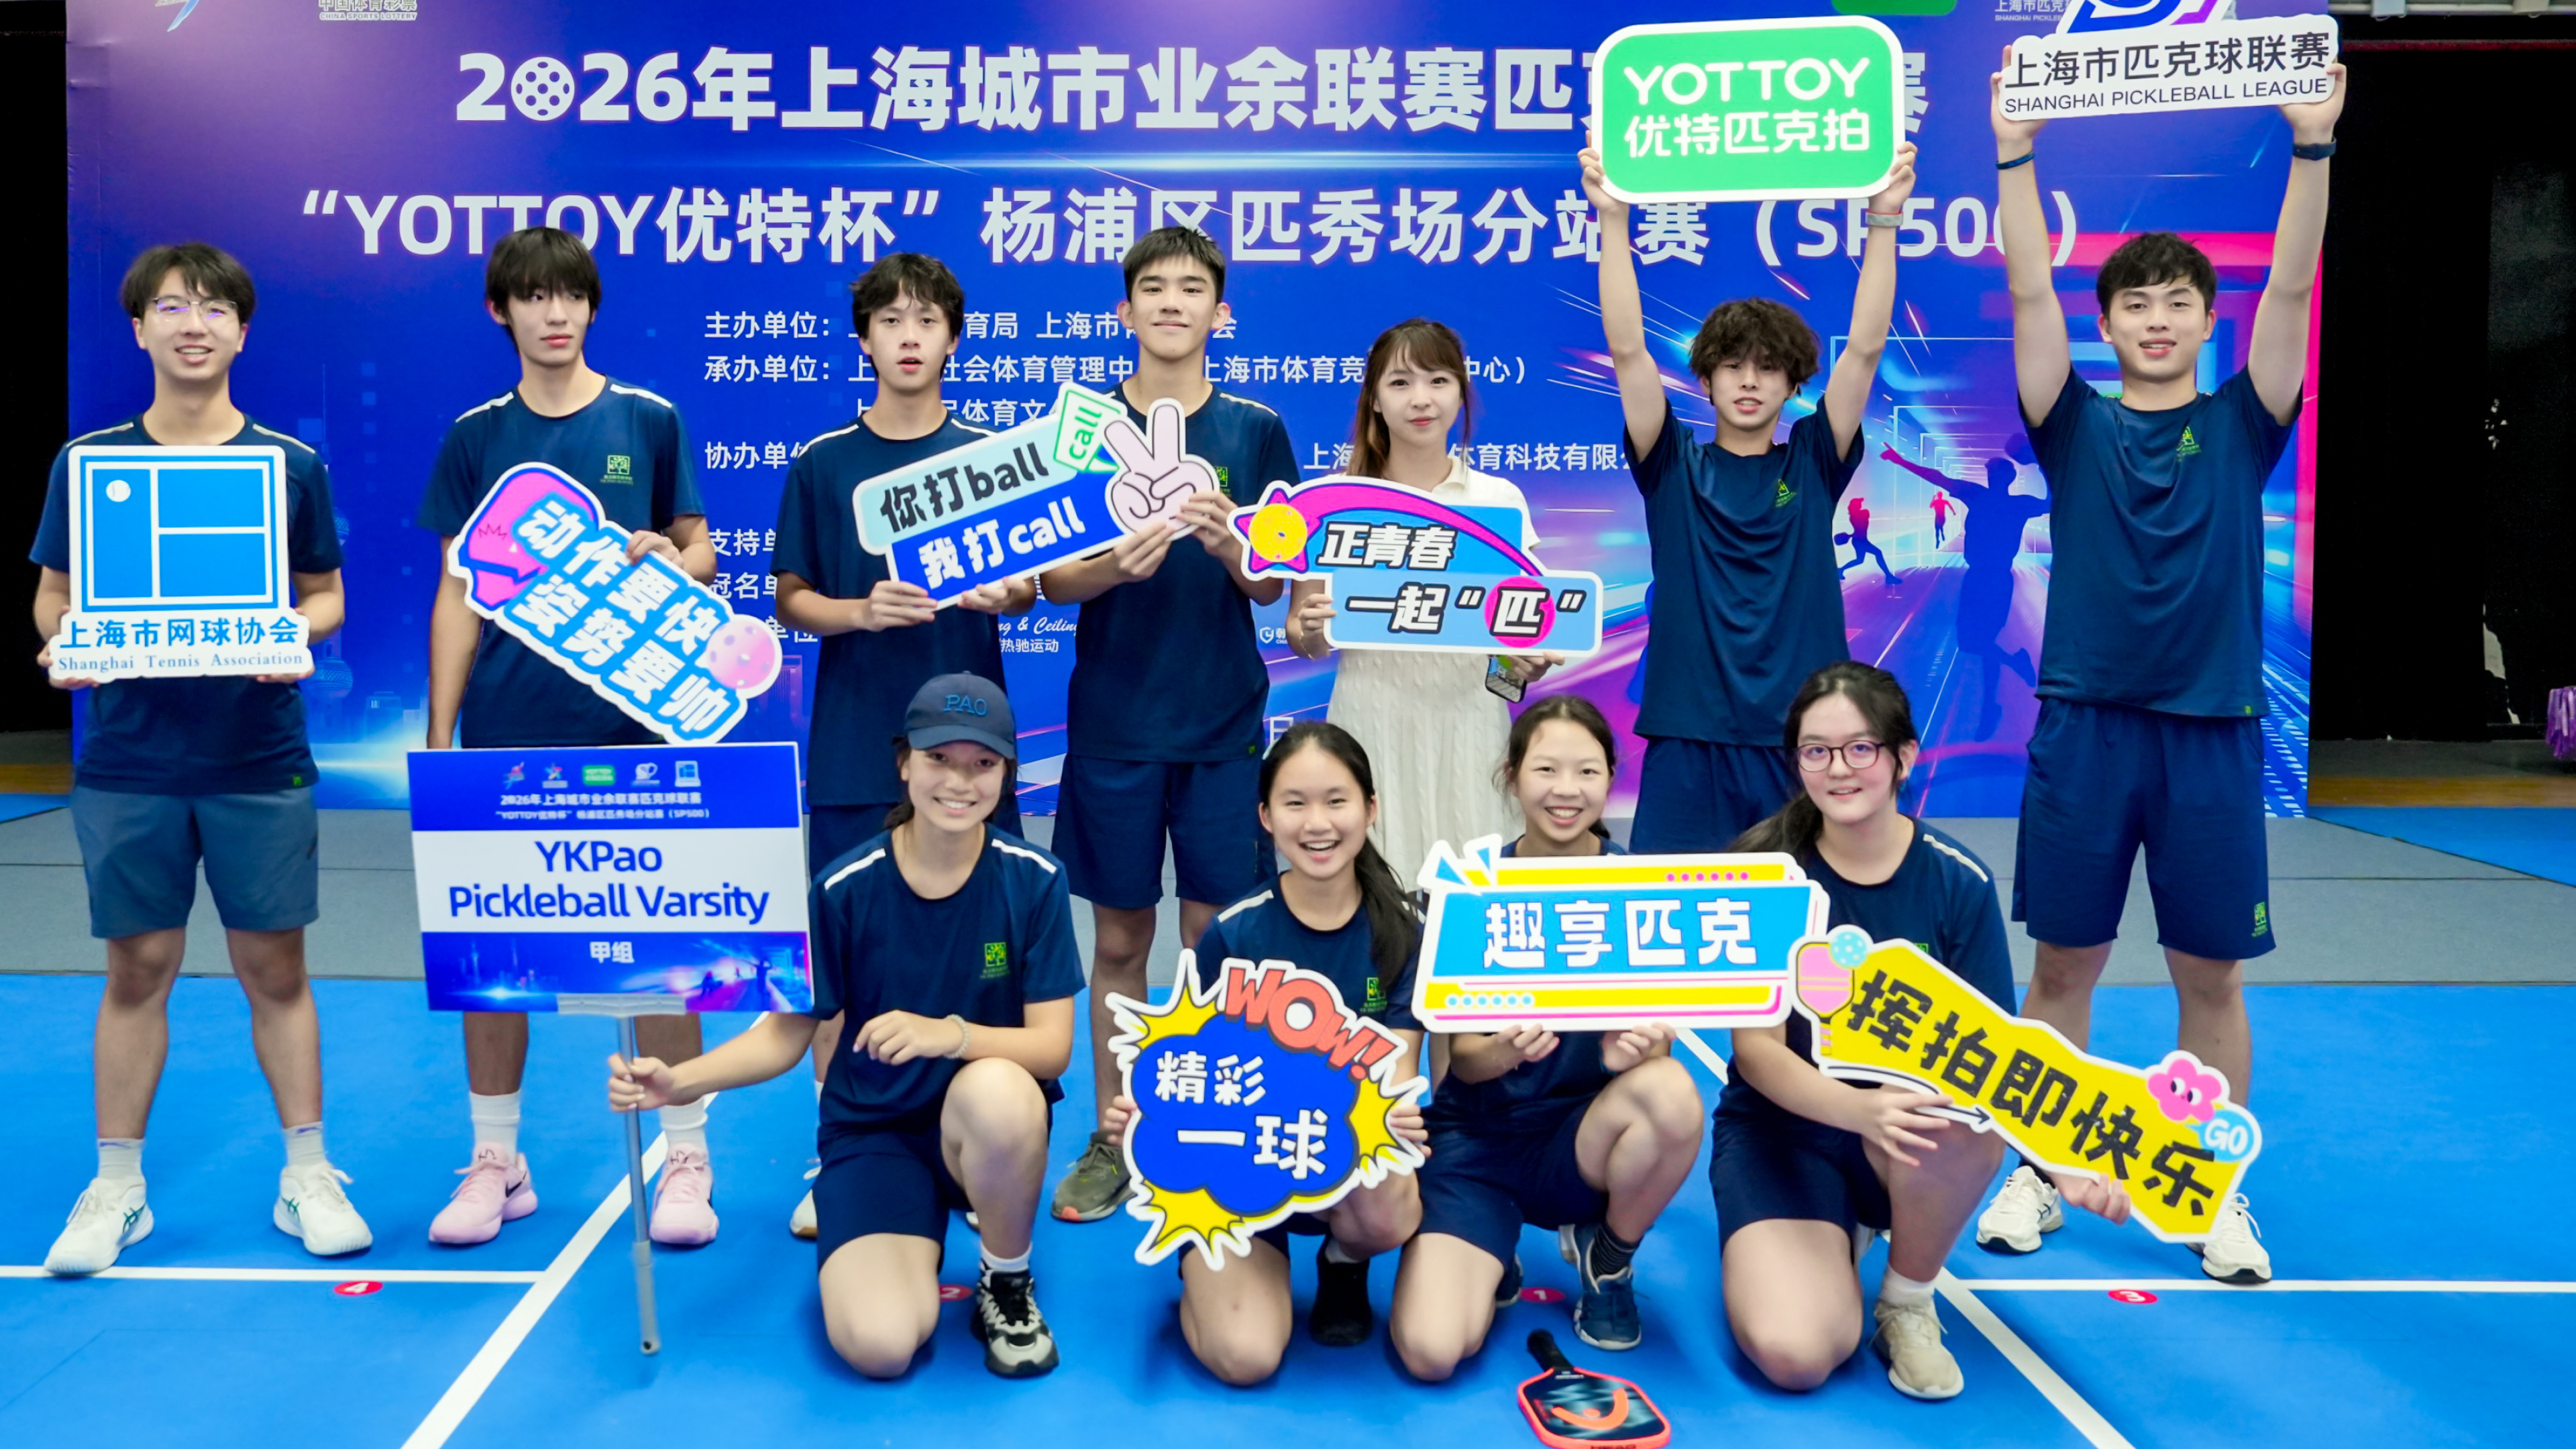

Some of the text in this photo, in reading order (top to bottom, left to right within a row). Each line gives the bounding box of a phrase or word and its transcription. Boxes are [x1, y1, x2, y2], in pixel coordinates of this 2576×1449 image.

[1624, 57, 1870, 105] YOTTOY
[2004, 31, 2330, 89] 上海市匹克球联赛
[2005, 78, 2328, 113] SHANGHAI PICKLEBALL LEAGUE
[1624, 109, 1870, 158] 优特匹克拍
[1068, 406, 1102, 460] call
[1317, 523, 1454, 569] 正青春
[517, 499, 719, 667] 动作要快
[60, 616, 299, 648] 上海市网球协会
[1018, 616, 1028, 631] &
[58, 653, 303, 673] Shanghai Tennis Association
[511, 574, 731, 733] 姿势要帅
[943, 694, 987, 716] PAO
[535, 841, 663, 871] YKPao
[449, 883, 769, 924] Pickleball Varsity
[590, 942, 634, 963] 甲组
[1484, 898, 1757, 968] 趣享匹克
[1224, 966, 1397, 1081] WOW!
[1155, 1051, 1266, 1107] 精彩
[1847, 969, 2215, 1216] 挥拍即快乐
[1177, 1109, 1328, 1179] 一球
[2204, 1118, 2249, 1155] GO
[344, 1282, 369, 1293] 4
[941, 1287, 961, 1298] 2
[2119, 1291, 2145, 1302] 3
